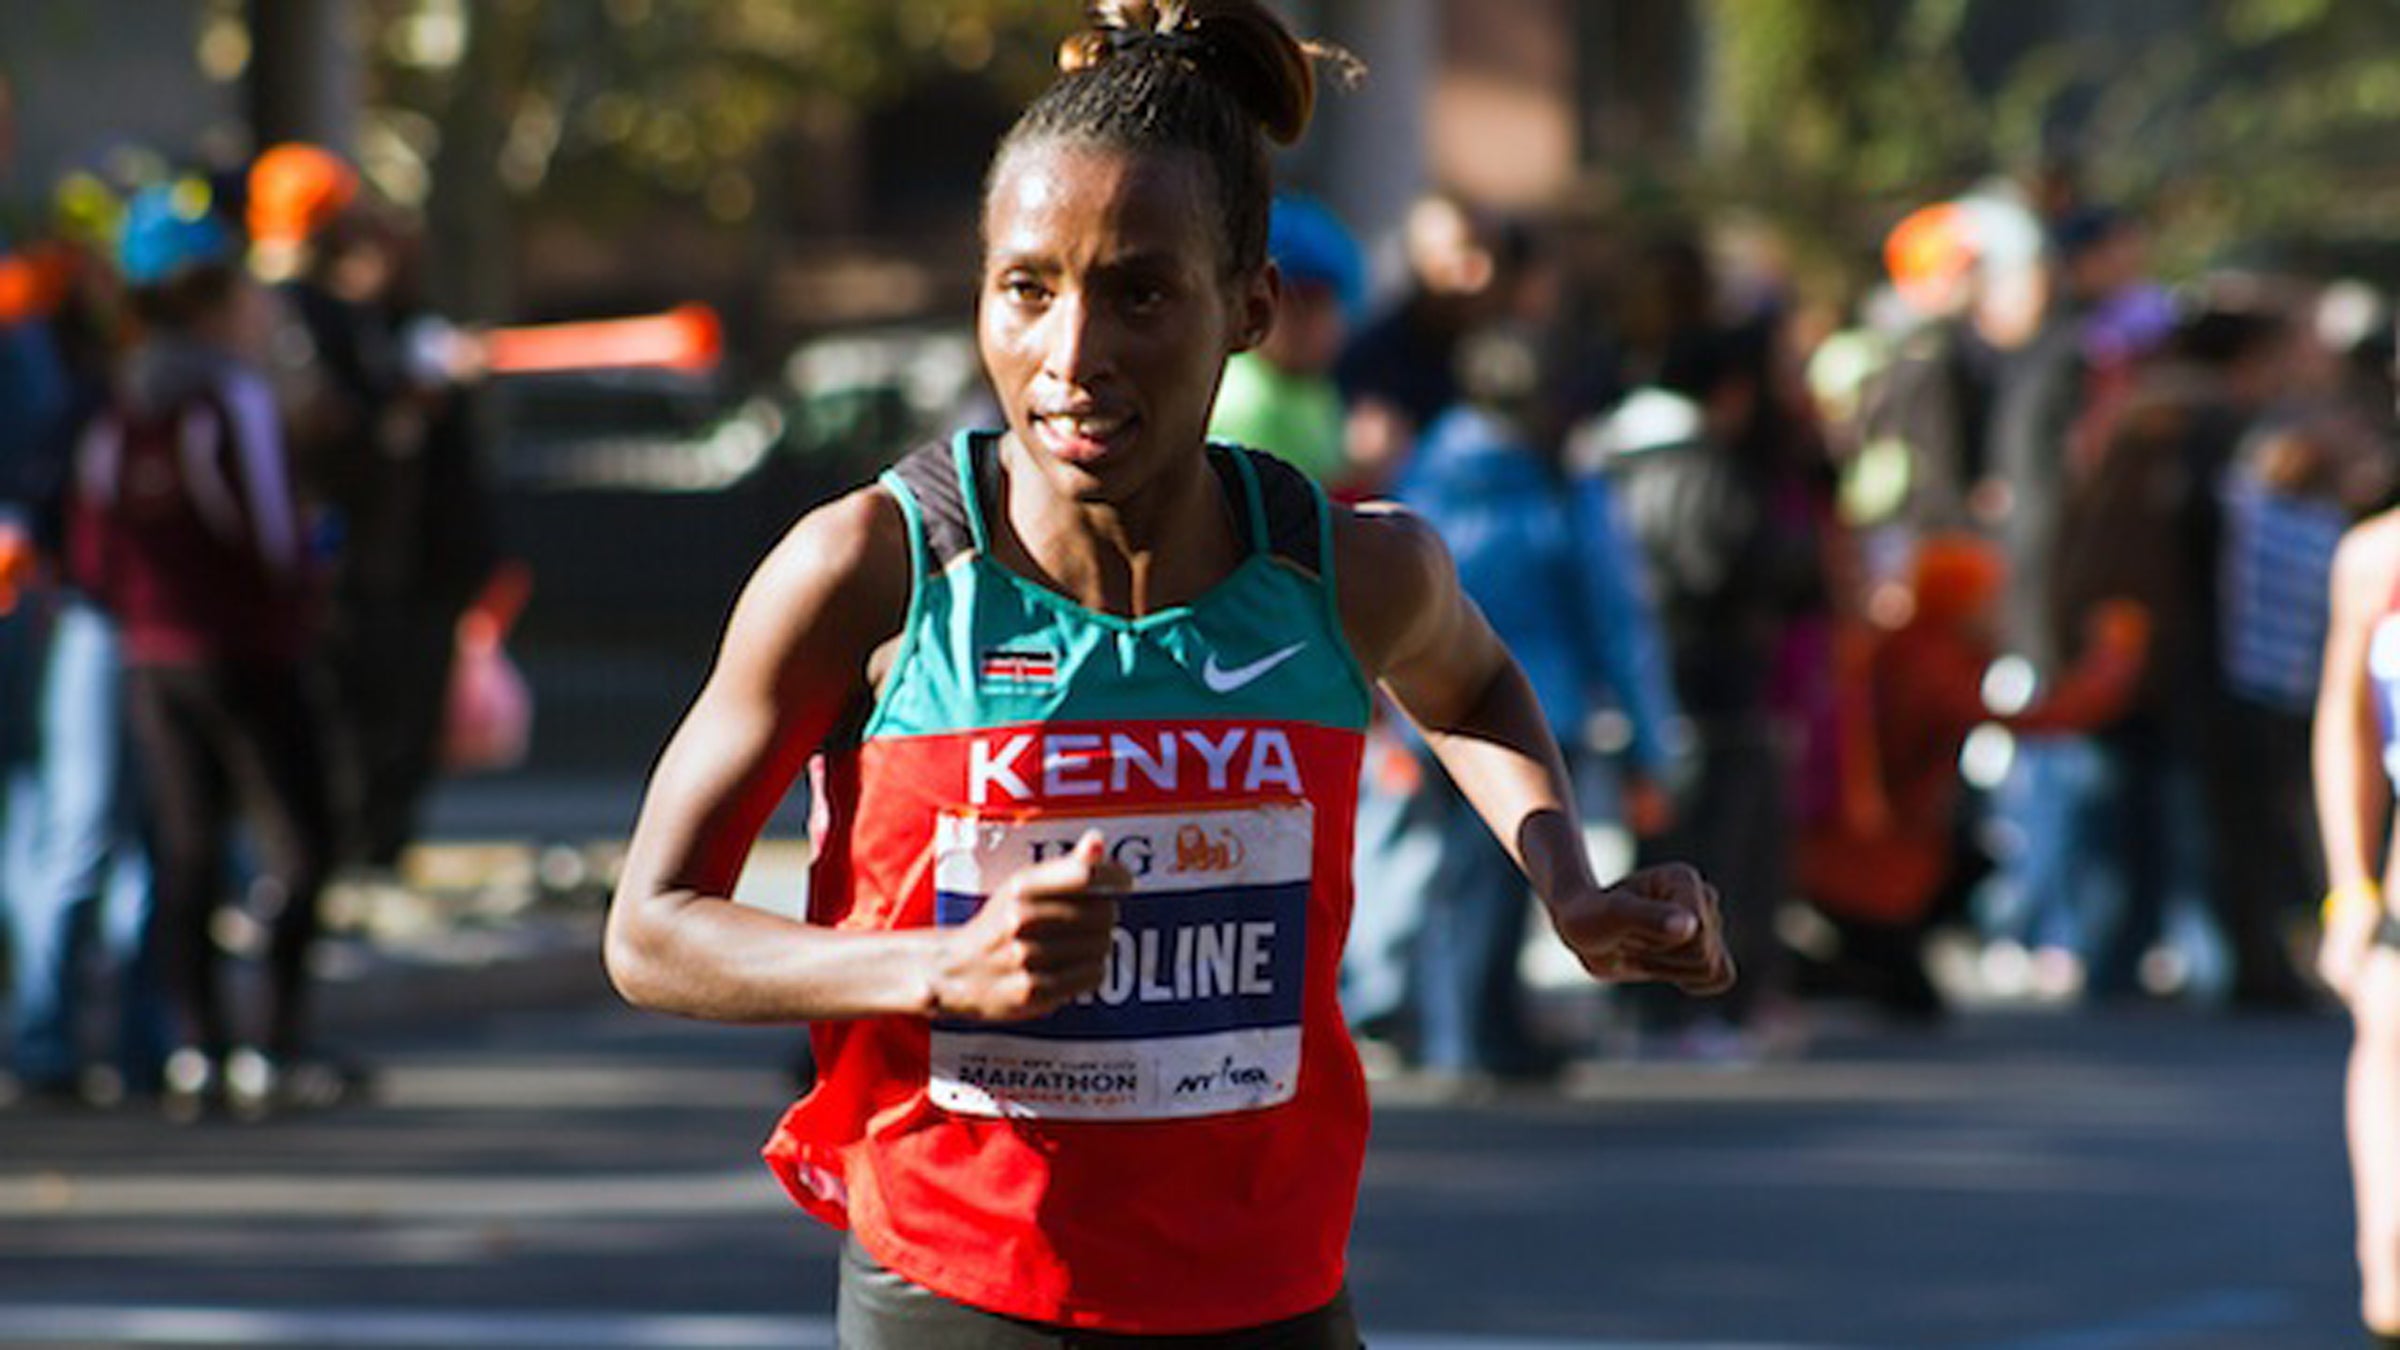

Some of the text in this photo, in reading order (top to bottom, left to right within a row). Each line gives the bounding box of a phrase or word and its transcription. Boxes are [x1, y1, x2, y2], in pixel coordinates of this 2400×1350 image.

[968, 728, 1304, 804] KENYA
[1029, 836, 1152, 877] IG
[1076, 921, 1276, 1005] OLINE
[959, 1066, 1137, 1093] MARATHON
